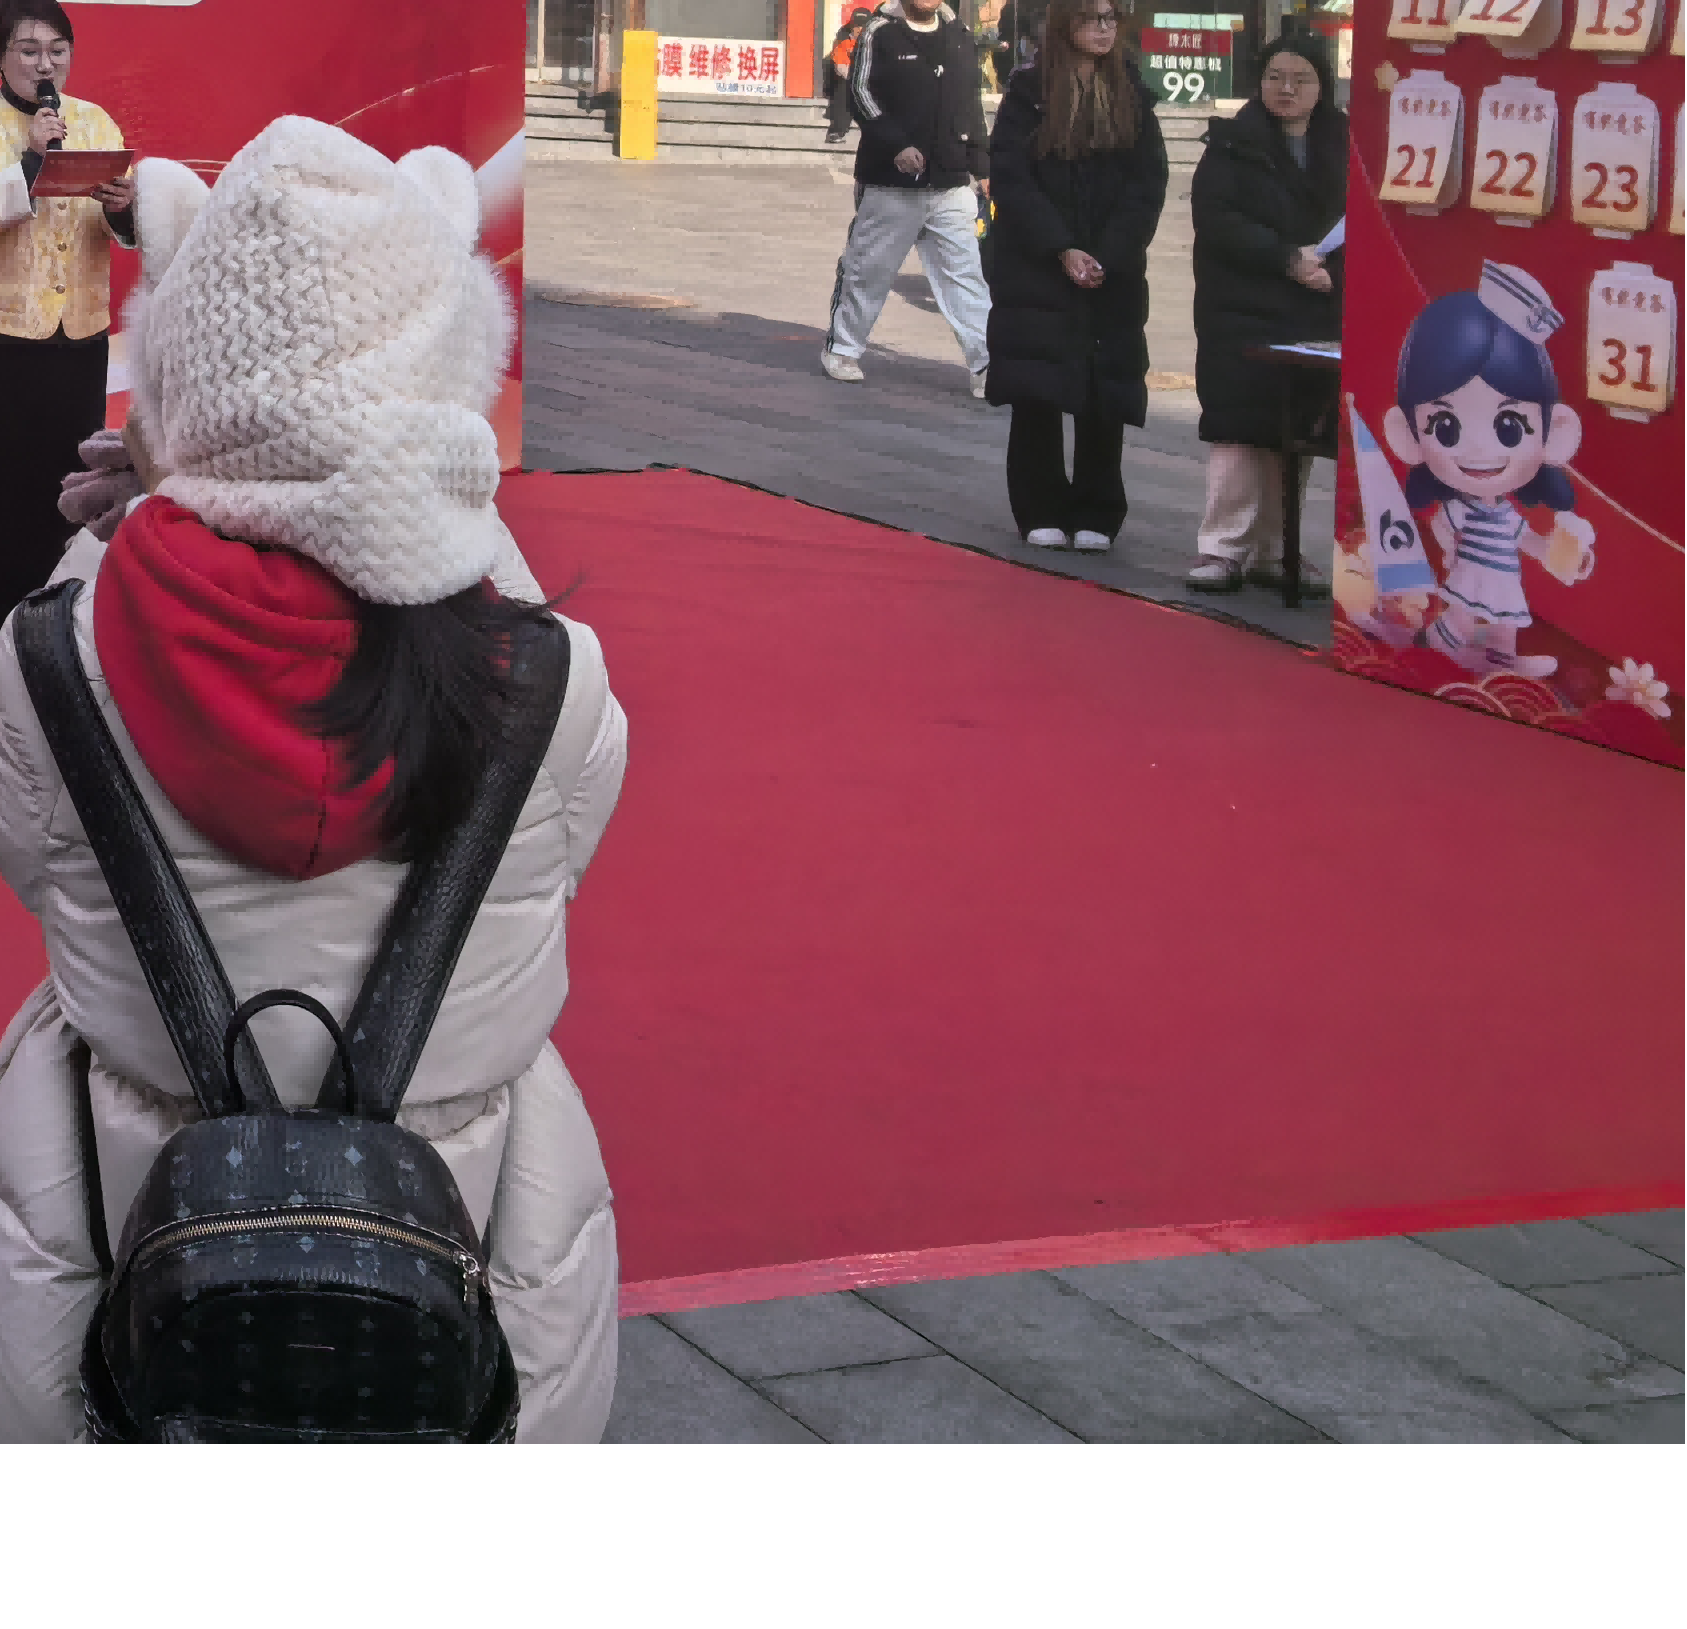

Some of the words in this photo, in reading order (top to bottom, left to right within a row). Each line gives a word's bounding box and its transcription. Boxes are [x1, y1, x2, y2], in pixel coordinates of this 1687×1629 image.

[1162, 71, 1205, 103] 99
[1390, 144, 1438, 189] 21
[1478, 149, 1539, 198] 22
[1581, 162, 1640, 213] 23
[1598, 338, 1659, 393] 31
